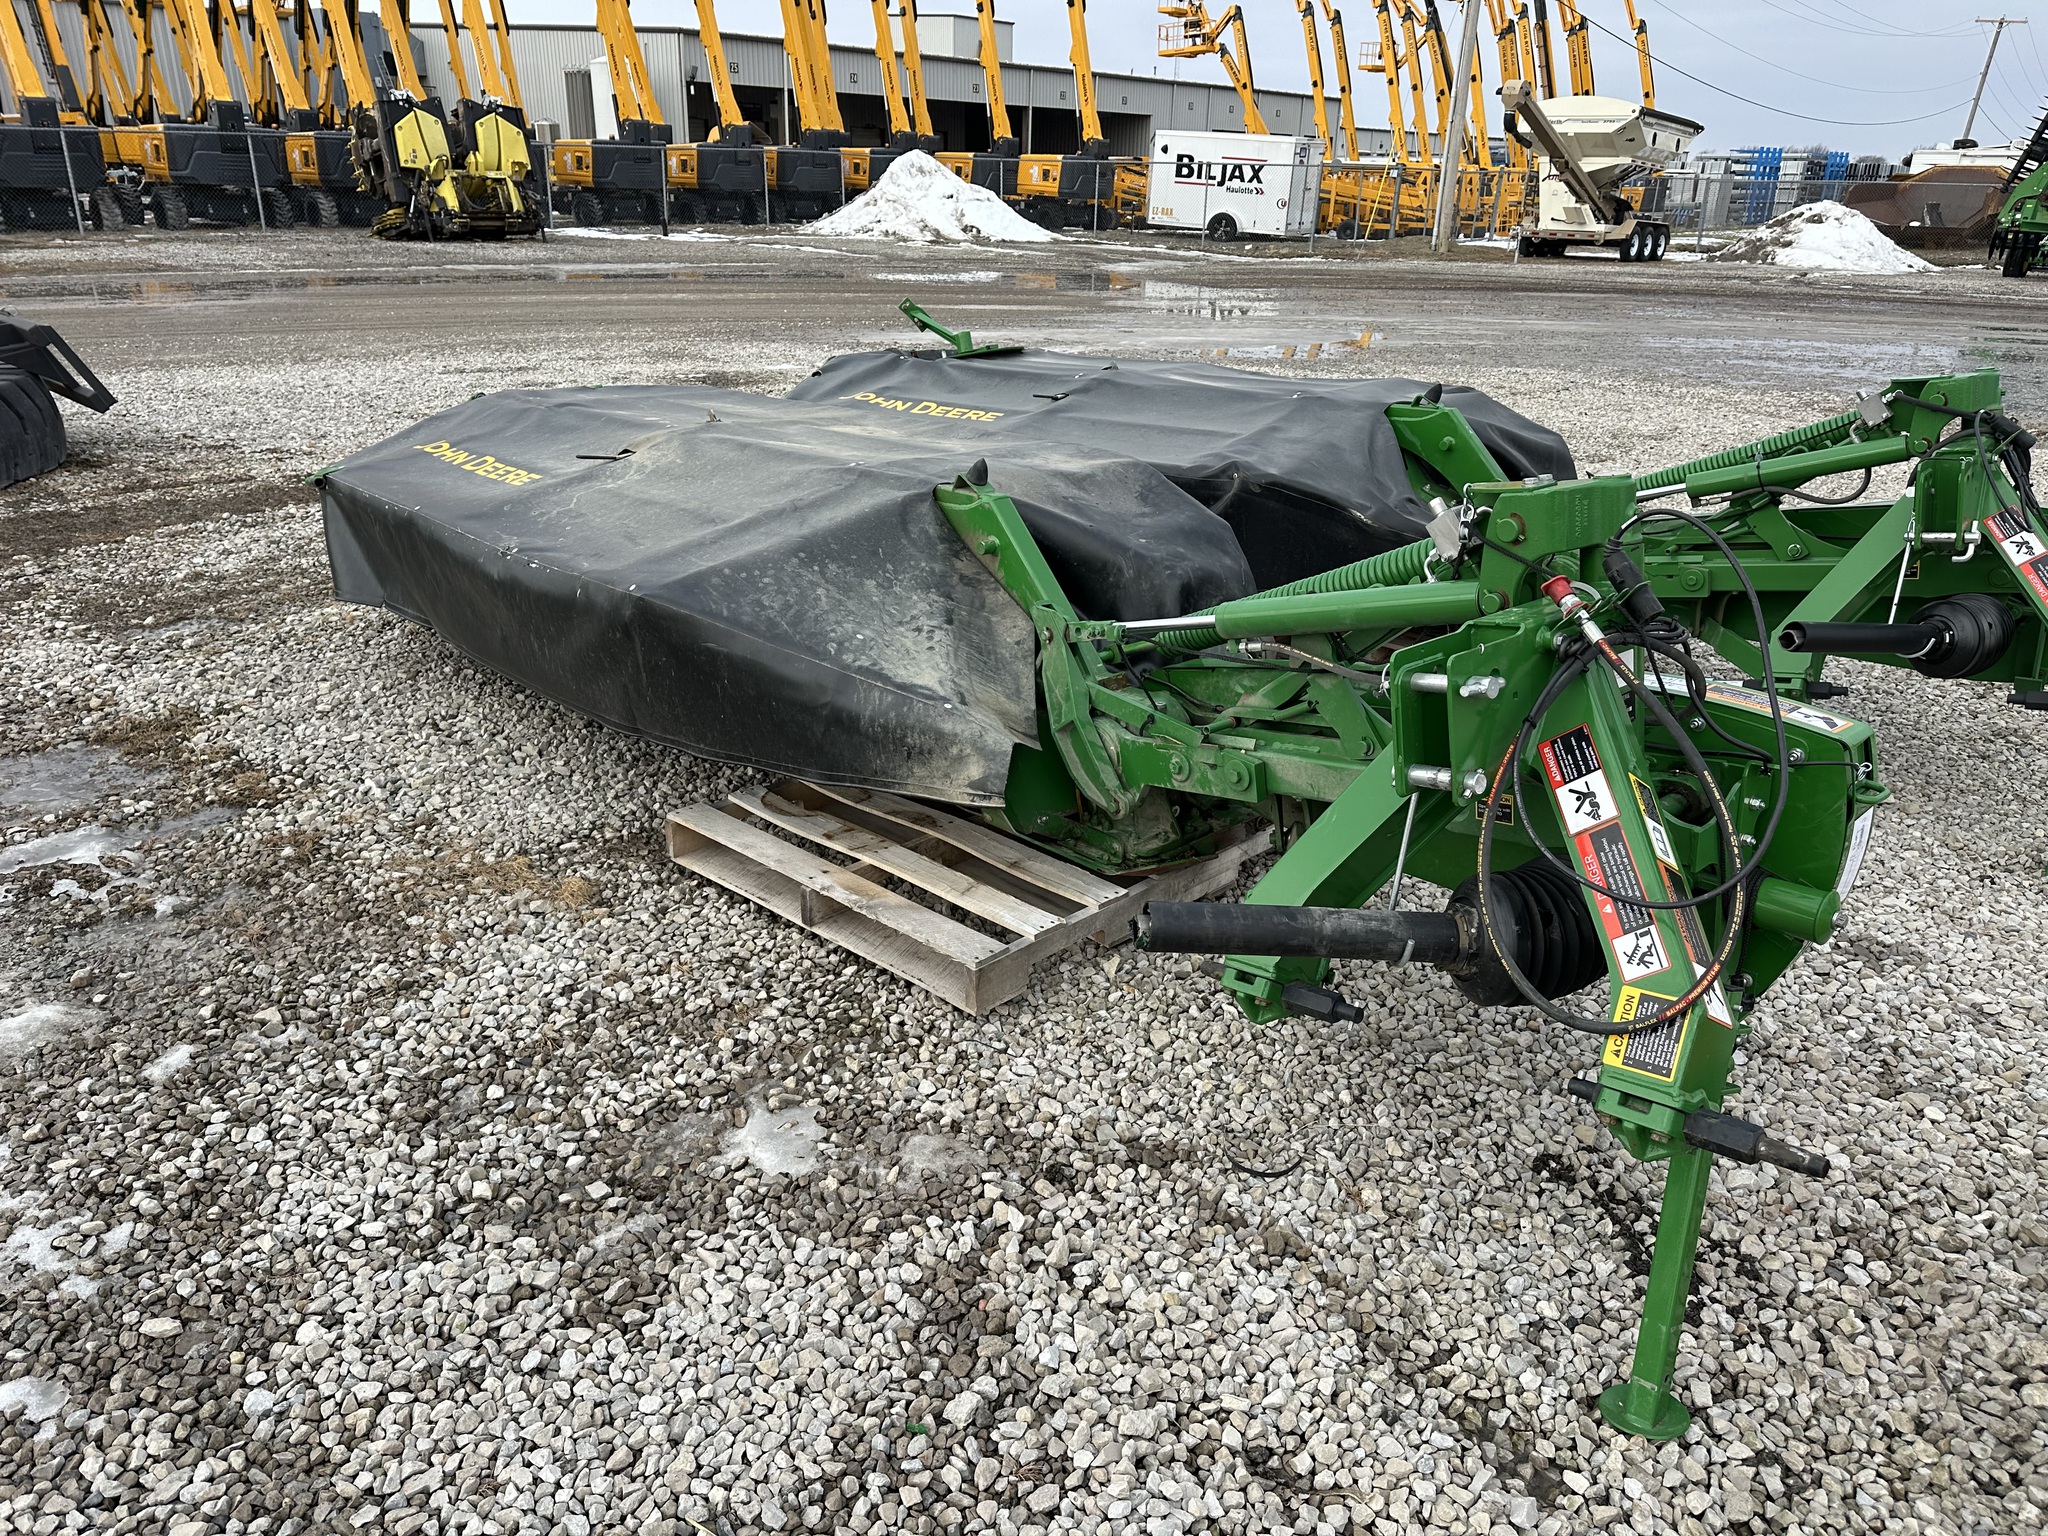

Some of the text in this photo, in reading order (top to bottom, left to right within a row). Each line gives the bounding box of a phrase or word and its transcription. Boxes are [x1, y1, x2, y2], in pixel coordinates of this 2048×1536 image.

[730, 63, 738, 73] 25
[850, 74, 857, 83] 24
[1175, 154, 1266, 187] BILJAX
[1226, 185, 1253, 195] Haulotte
[838, 391, 1004, 422] JOHN DEERE
[413, 440, 542, 486] JOHN DEERE
[2028, 573, 2048, 597] DANGER
[1543, 746, 1560, 777] DANGER
[1717, 801, 1728, 820] Resistant
[1601, 837, 1610, 851] folded
[1599, 851, 1607, 863] clear
[1606, 851, 1615, 864] being
[1610, 843, 1622, 864] hydraulic
[1603, 862, 1611, 876] stand
[1627, 869, 1636, 884] wings
[1584, 854, 1607, 900] DNGER
[1607, 876, 1616, 890] death
[1614, 873, 1623, 887] wings
[1619, 869, 1633, 896] Mechanical
[1632, 884, 1640, 897] allow
[1619, 909, 1628, 922] avoid
[1640, 906, 1649, 922] failure
[1635, 1018, 1658, 1029] BALFLEX
[1666, 1000, 1687, 1017] BALPAC
[1688, 977, 1709, 1001] PREMIUM
[1613, 994, 1635, 1047] CATION
[1635, 1044, 1643, 1059] engine
